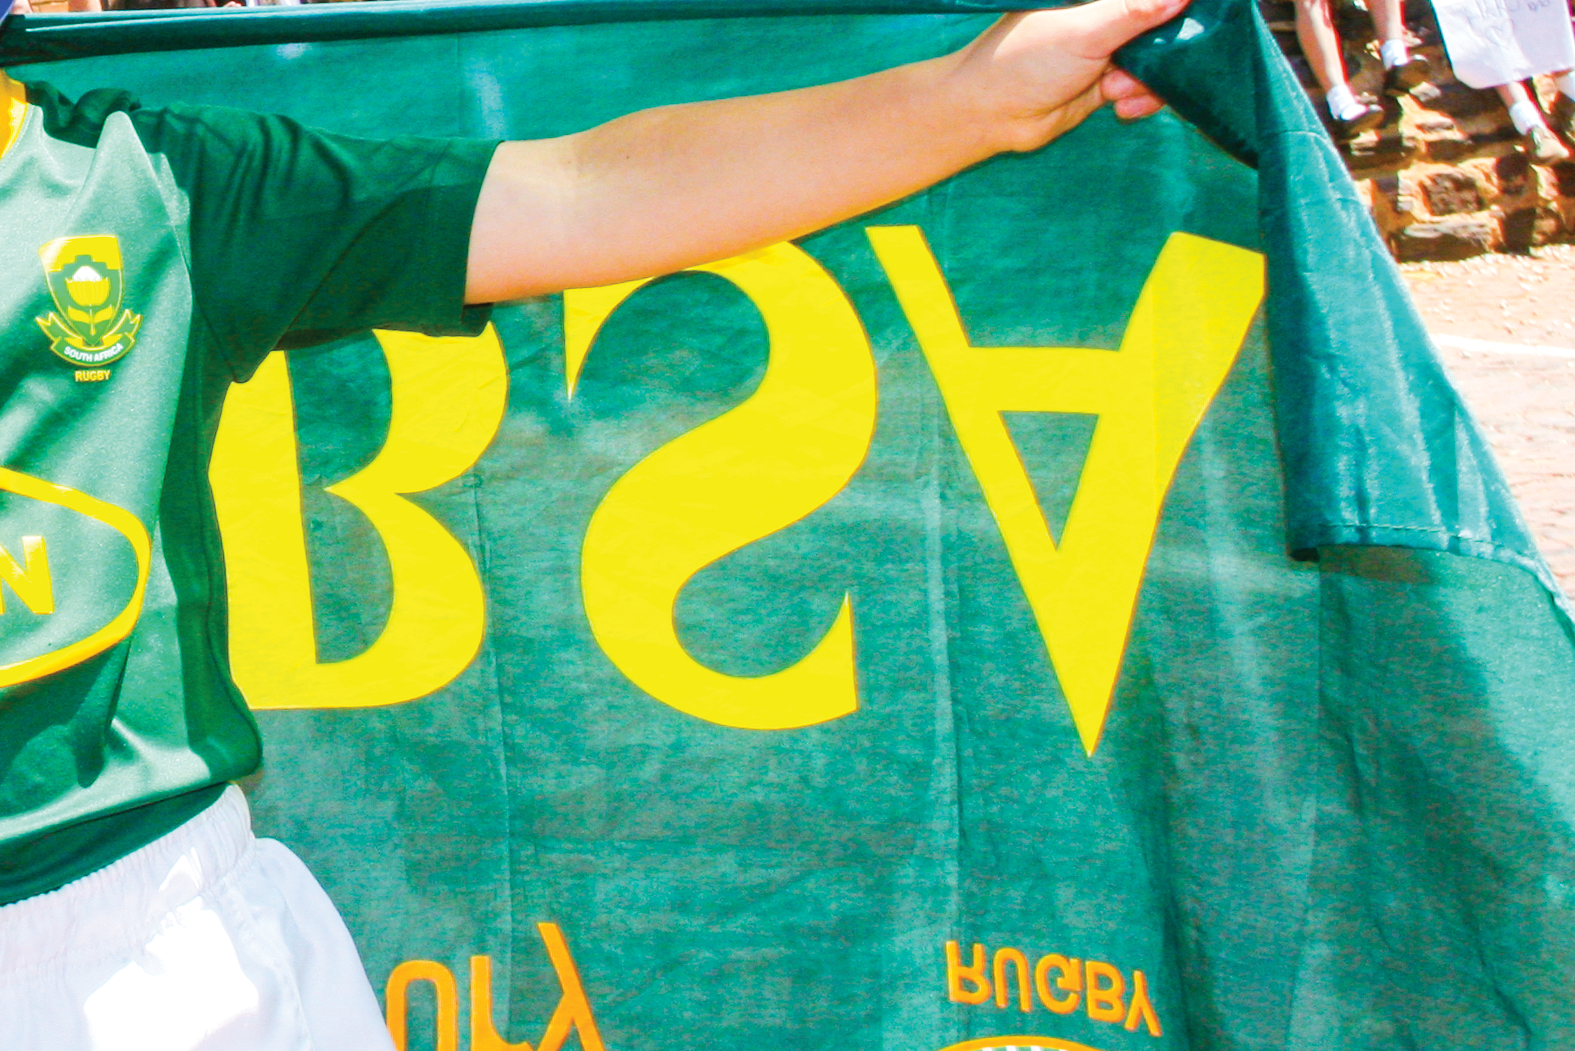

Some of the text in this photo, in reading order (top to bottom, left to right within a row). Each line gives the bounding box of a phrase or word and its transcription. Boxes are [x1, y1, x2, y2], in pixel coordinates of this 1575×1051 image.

[63, 342, 125, 363] SOUTH AFRICA
[74, 368, 112, 383] RUGBY
